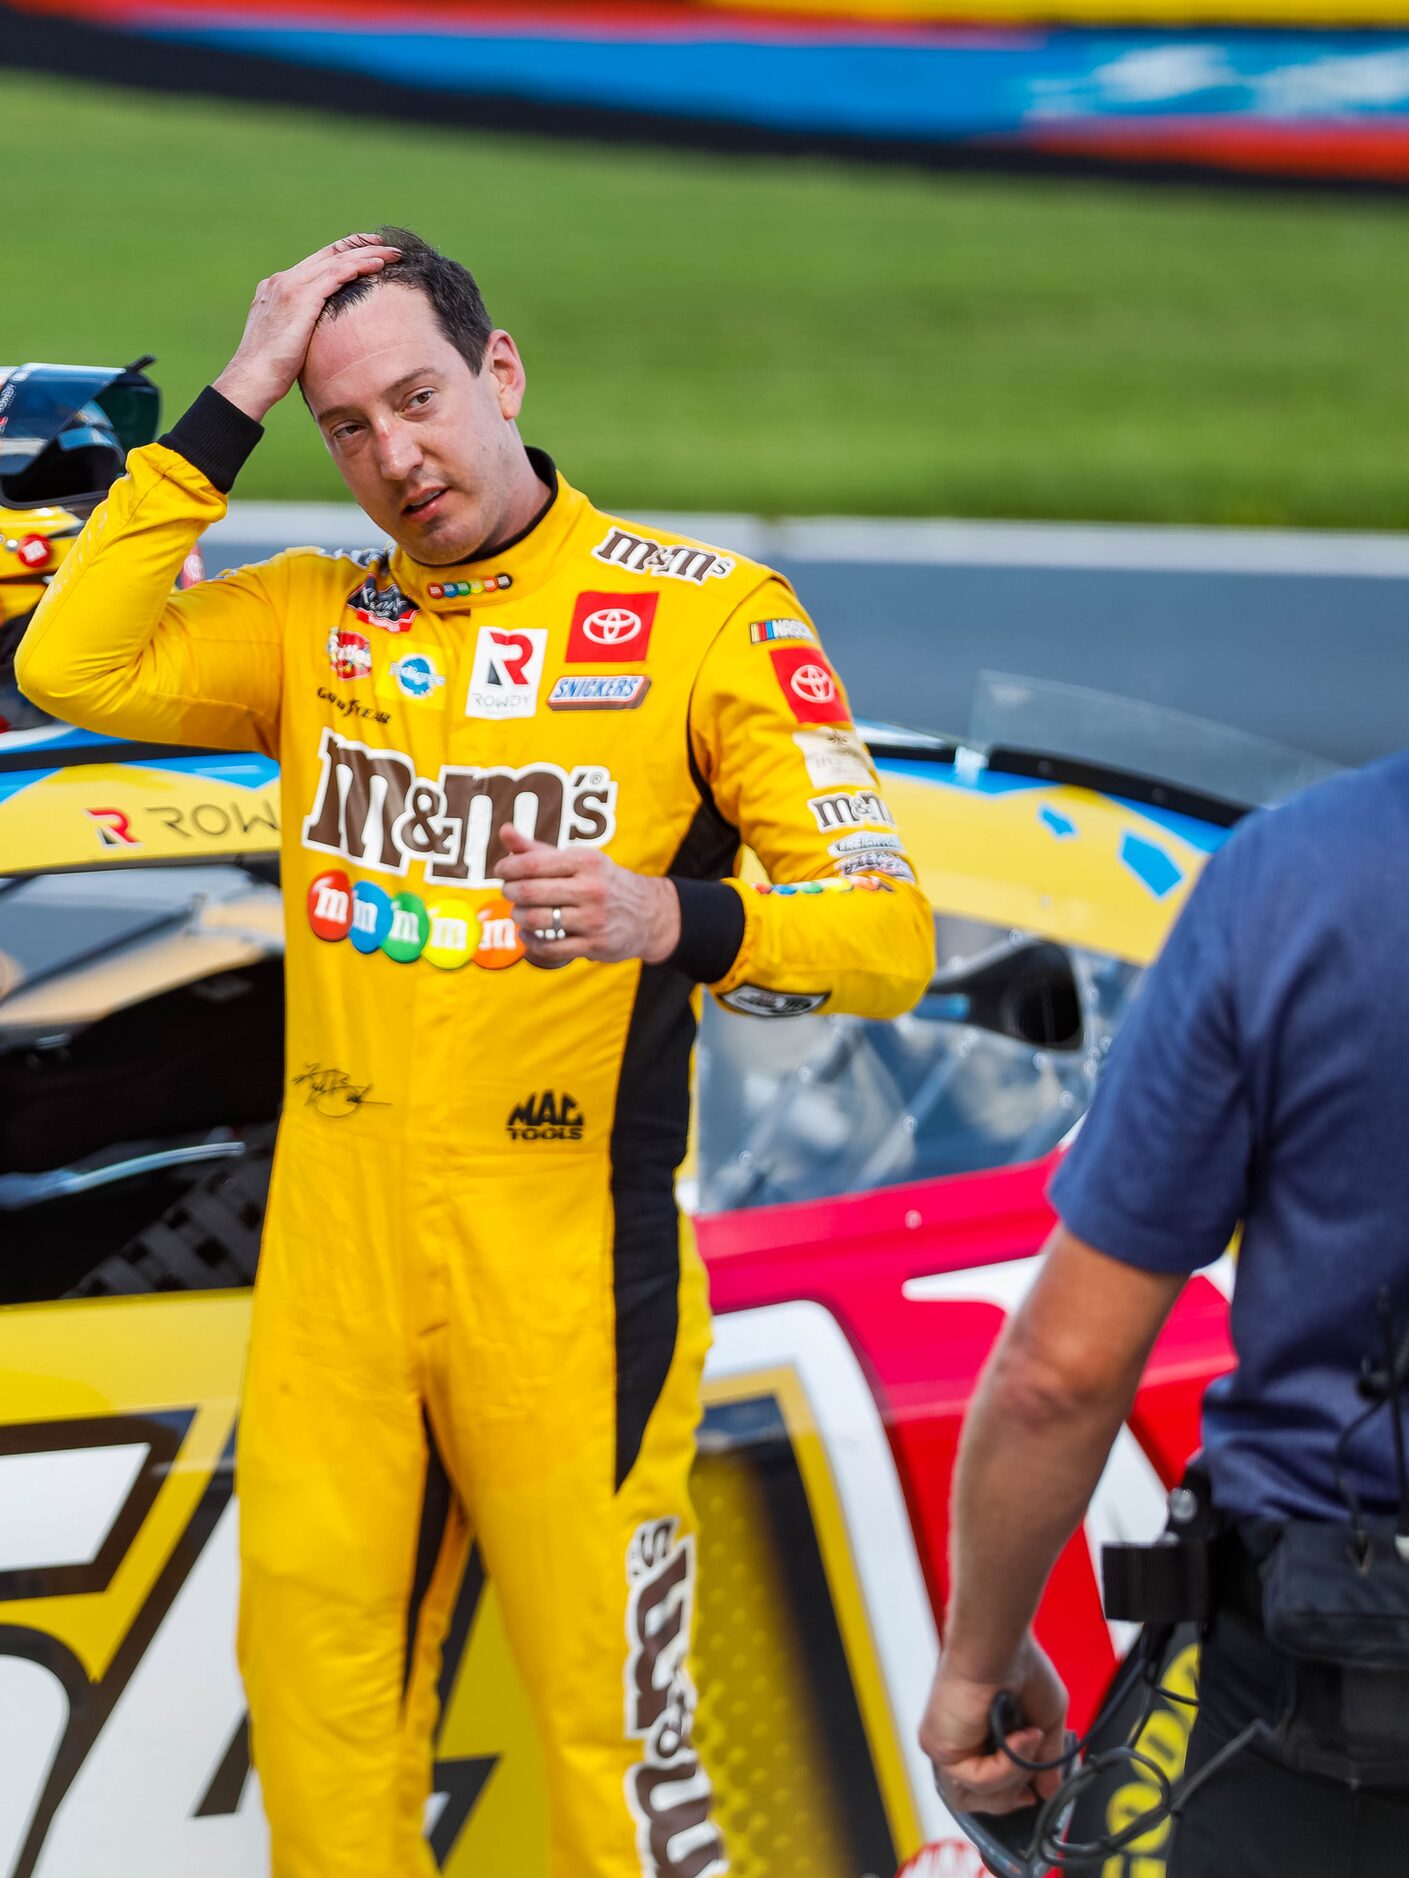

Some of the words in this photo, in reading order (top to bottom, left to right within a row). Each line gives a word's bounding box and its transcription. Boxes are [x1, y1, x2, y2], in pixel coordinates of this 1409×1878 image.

[555, 678, 638, 698] SNICKERS
[472, 692, 532, 708] ROWDY
[506, 1088, 584, 1126] MAC
[506, 1126, 583, 1141] TOOLS
